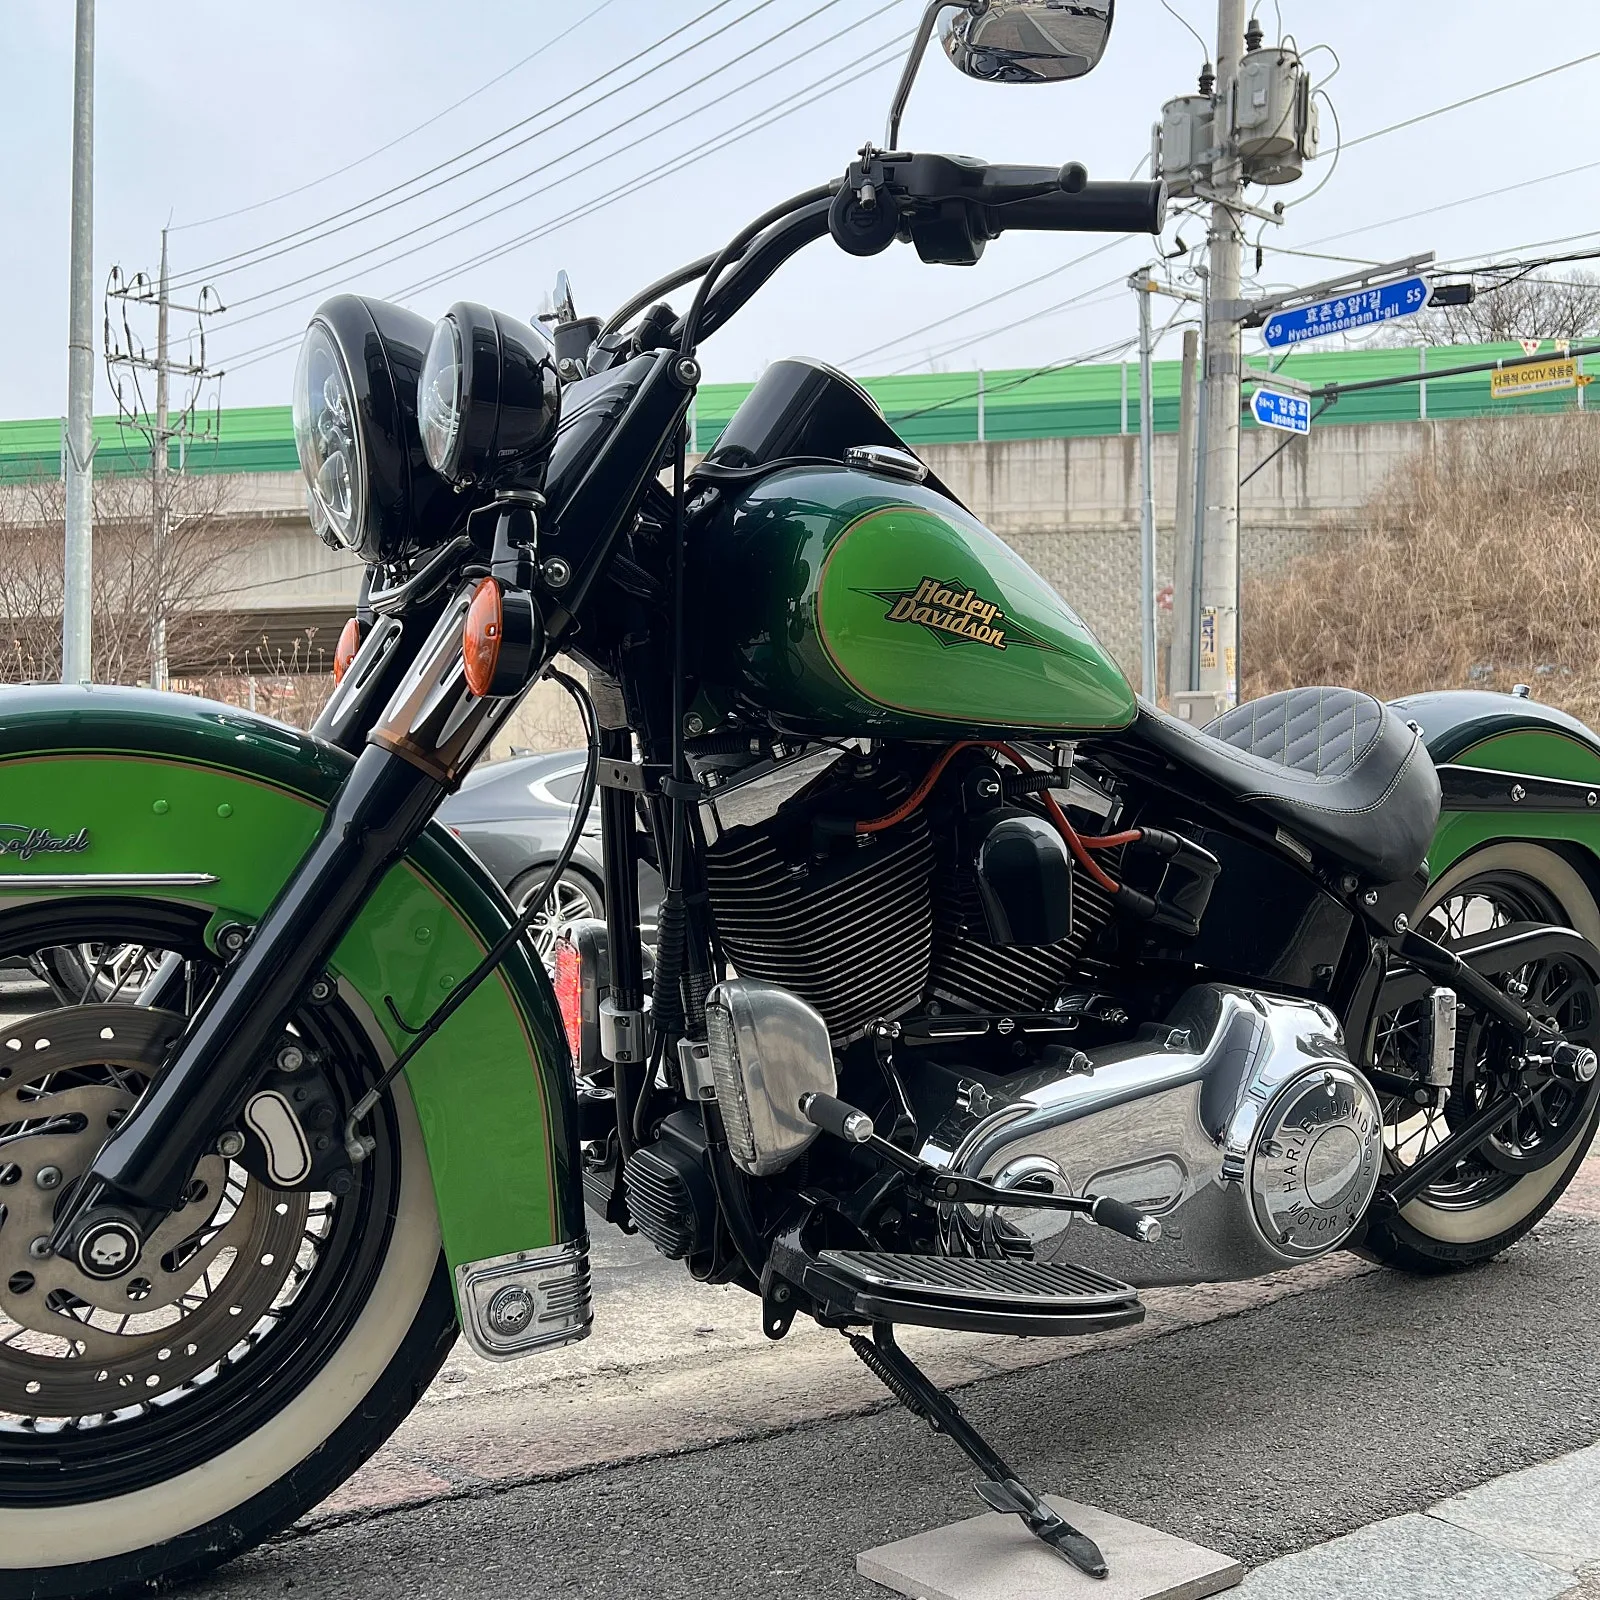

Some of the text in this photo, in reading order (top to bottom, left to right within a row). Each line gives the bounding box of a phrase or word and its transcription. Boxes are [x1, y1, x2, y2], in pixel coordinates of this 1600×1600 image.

[1305, 289, 1382, 324] 효촌송암1길
[1406, 288, 1421, 304] 55
[1268, 324, 1283, 340] 59
[1494, 372, 1519, 387] 다목적
[1521, 368, 1546, 381] CCTV
[1548, 364, 1574, 379] 작동중
[887, 596, 1007, 650] Davidson
[1283, 1100, 1373, 1193] HARLEY-DAVIDSON
[1288, 1200, 1338, 1232] MOTOR
